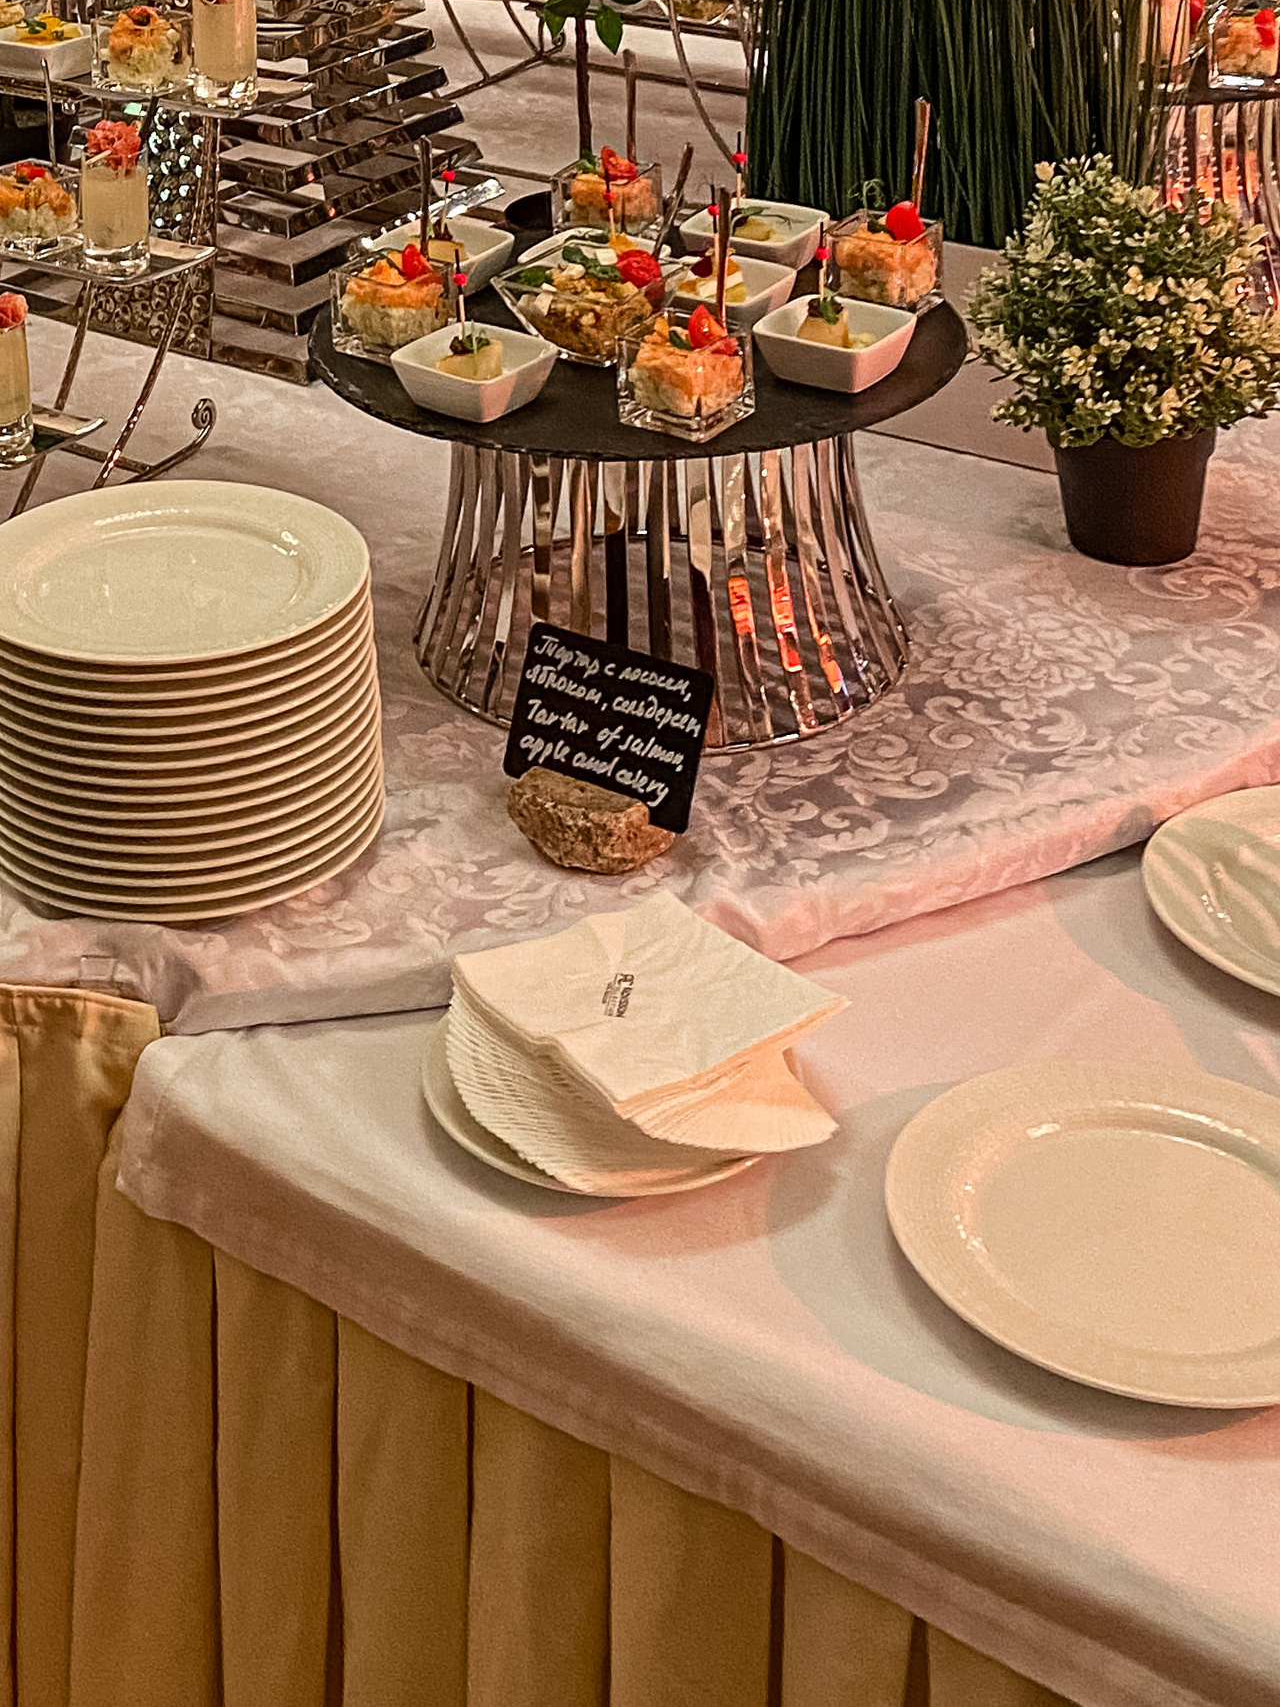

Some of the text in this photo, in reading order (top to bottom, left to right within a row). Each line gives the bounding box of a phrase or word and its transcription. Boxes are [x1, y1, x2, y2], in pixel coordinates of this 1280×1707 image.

[527, 698, 589, 735] Tartar
[596, 725, 622, 751] of
[519, 734, 572, 763] apple
[572, 751, 618, 777] and
